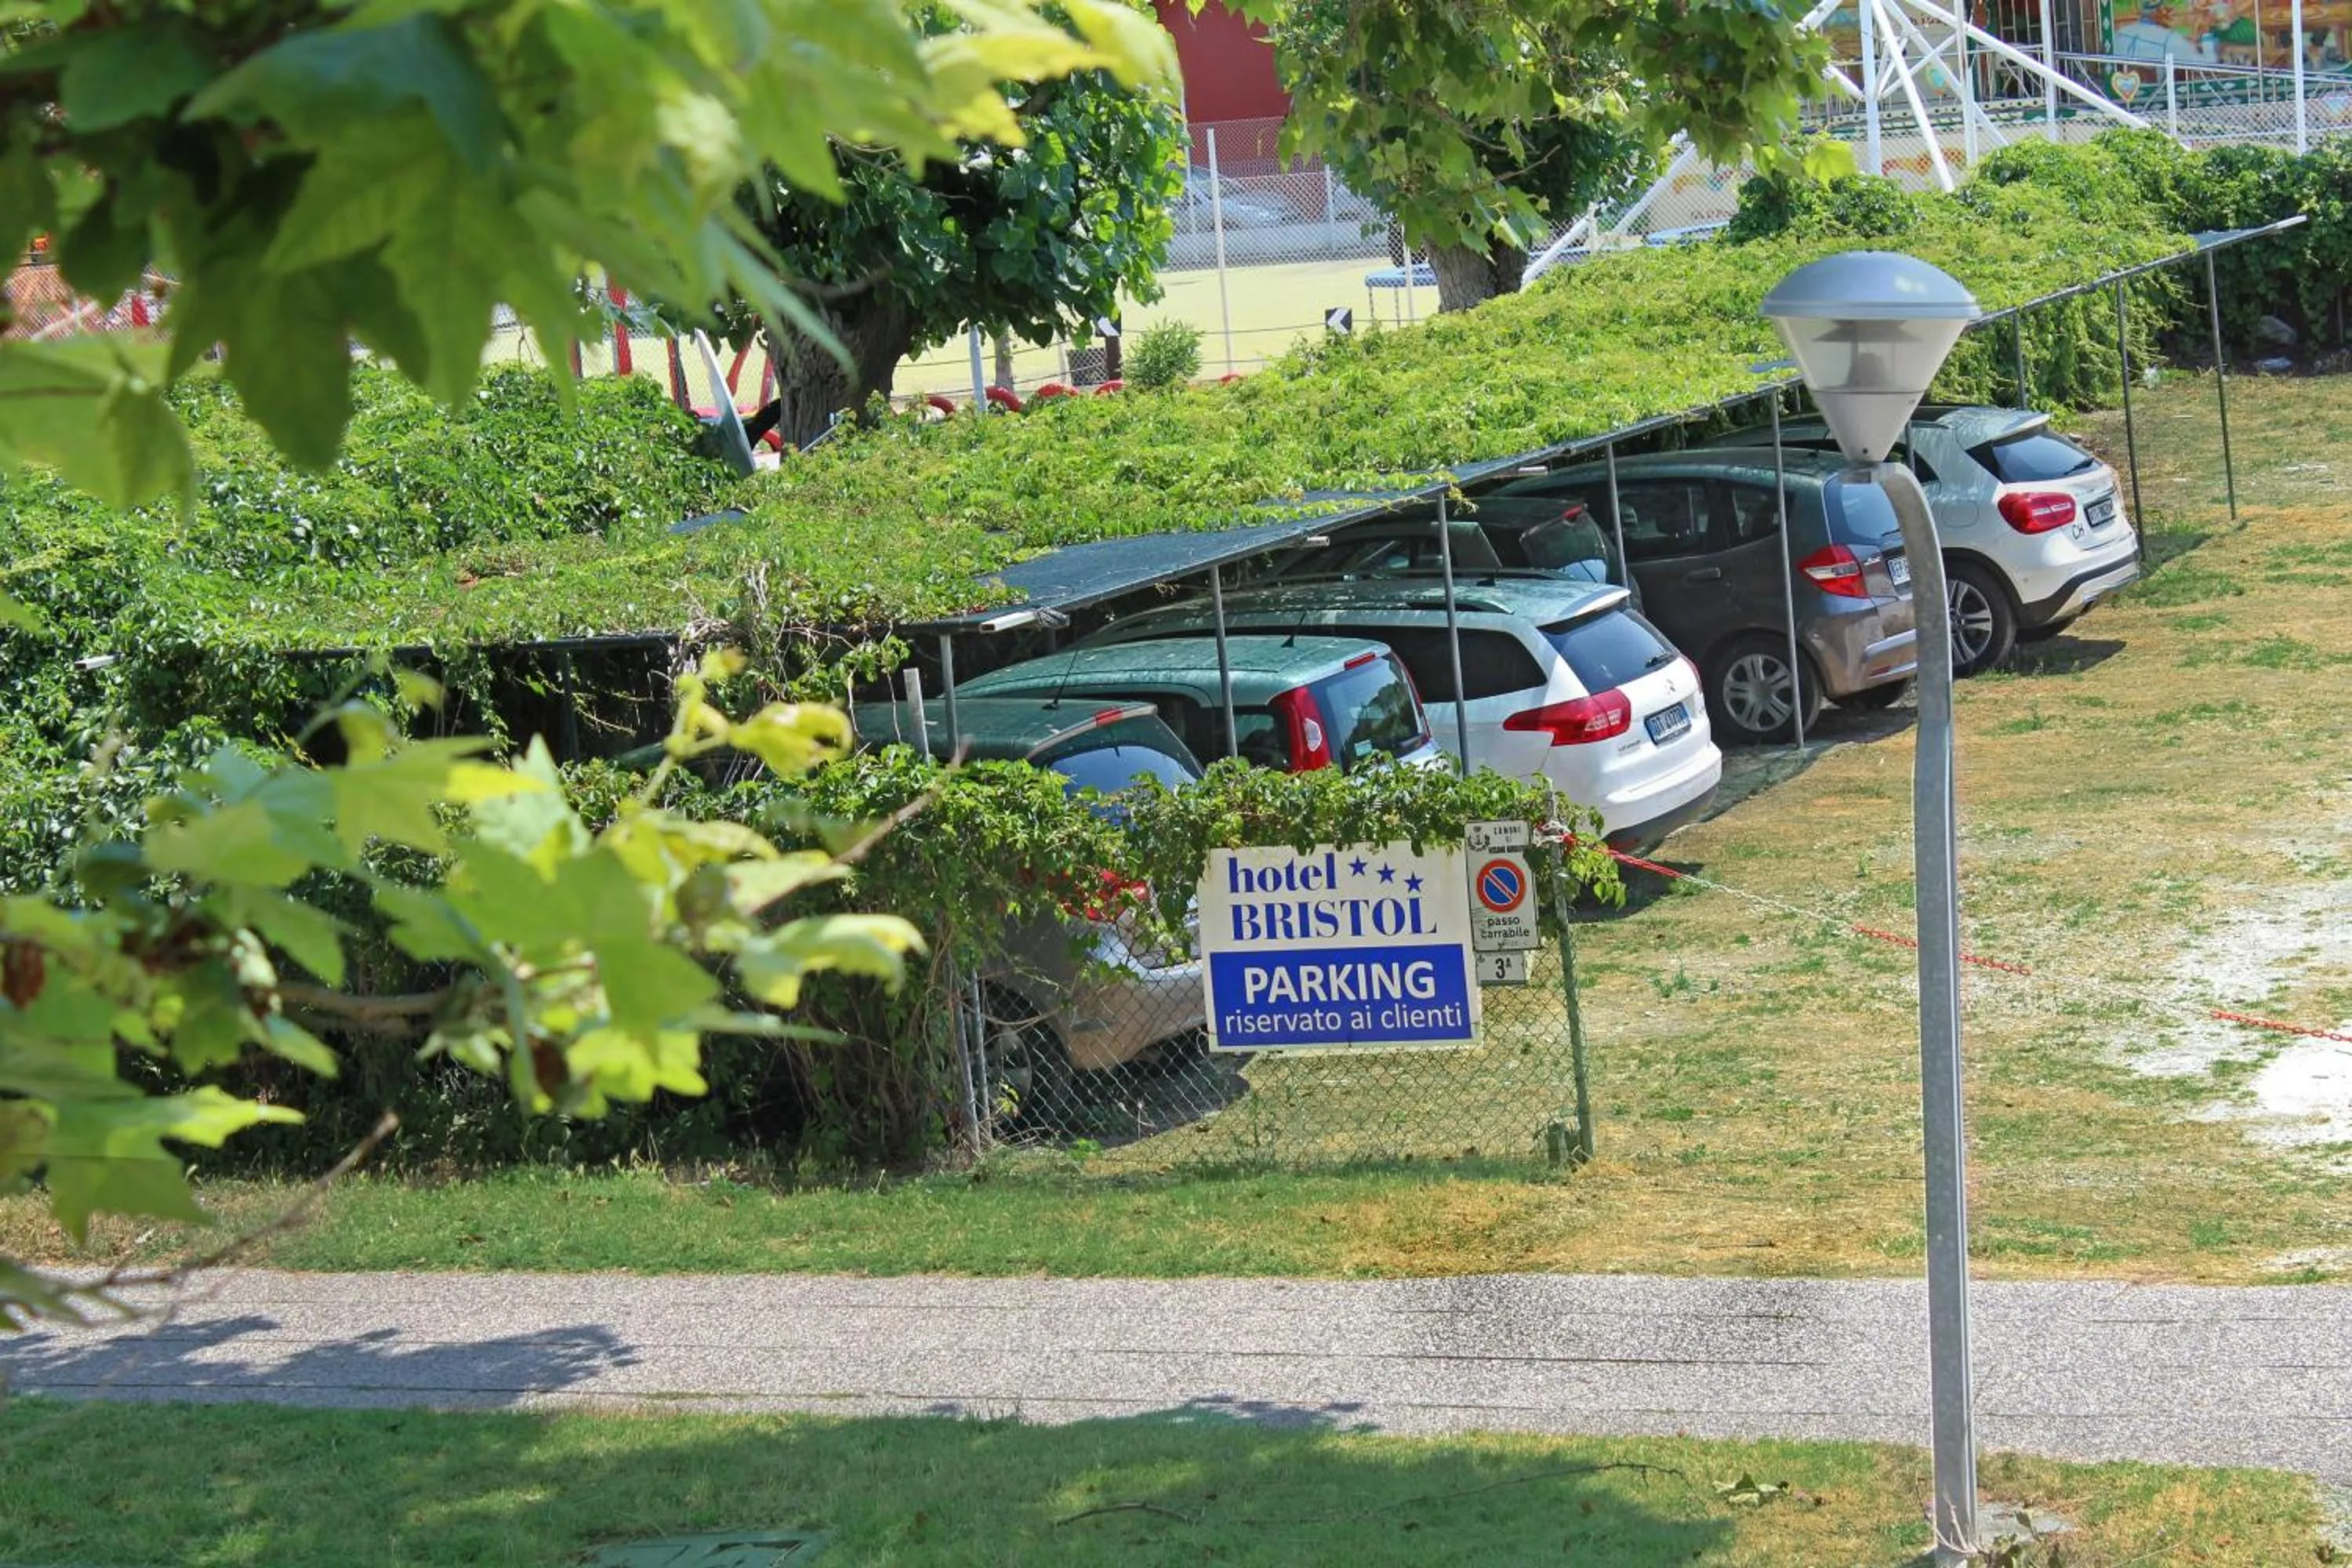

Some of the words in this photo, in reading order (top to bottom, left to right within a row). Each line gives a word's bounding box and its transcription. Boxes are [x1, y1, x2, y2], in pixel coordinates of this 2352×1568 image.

[1229, 852, 1337, 893] hotel
[1229, 898, 1437, 941] BRISTOL
[1481, 926, 1530, 938] carrabile
[1487, 916, 1520, 927] passo
[1243, 960, 1436, 1004] PARKING
[1225, 1008, 1341, 1034] riservato
[1351, 1005, 1372, 1029] ai
[1381, 1003, 1463, 1029] clienti
